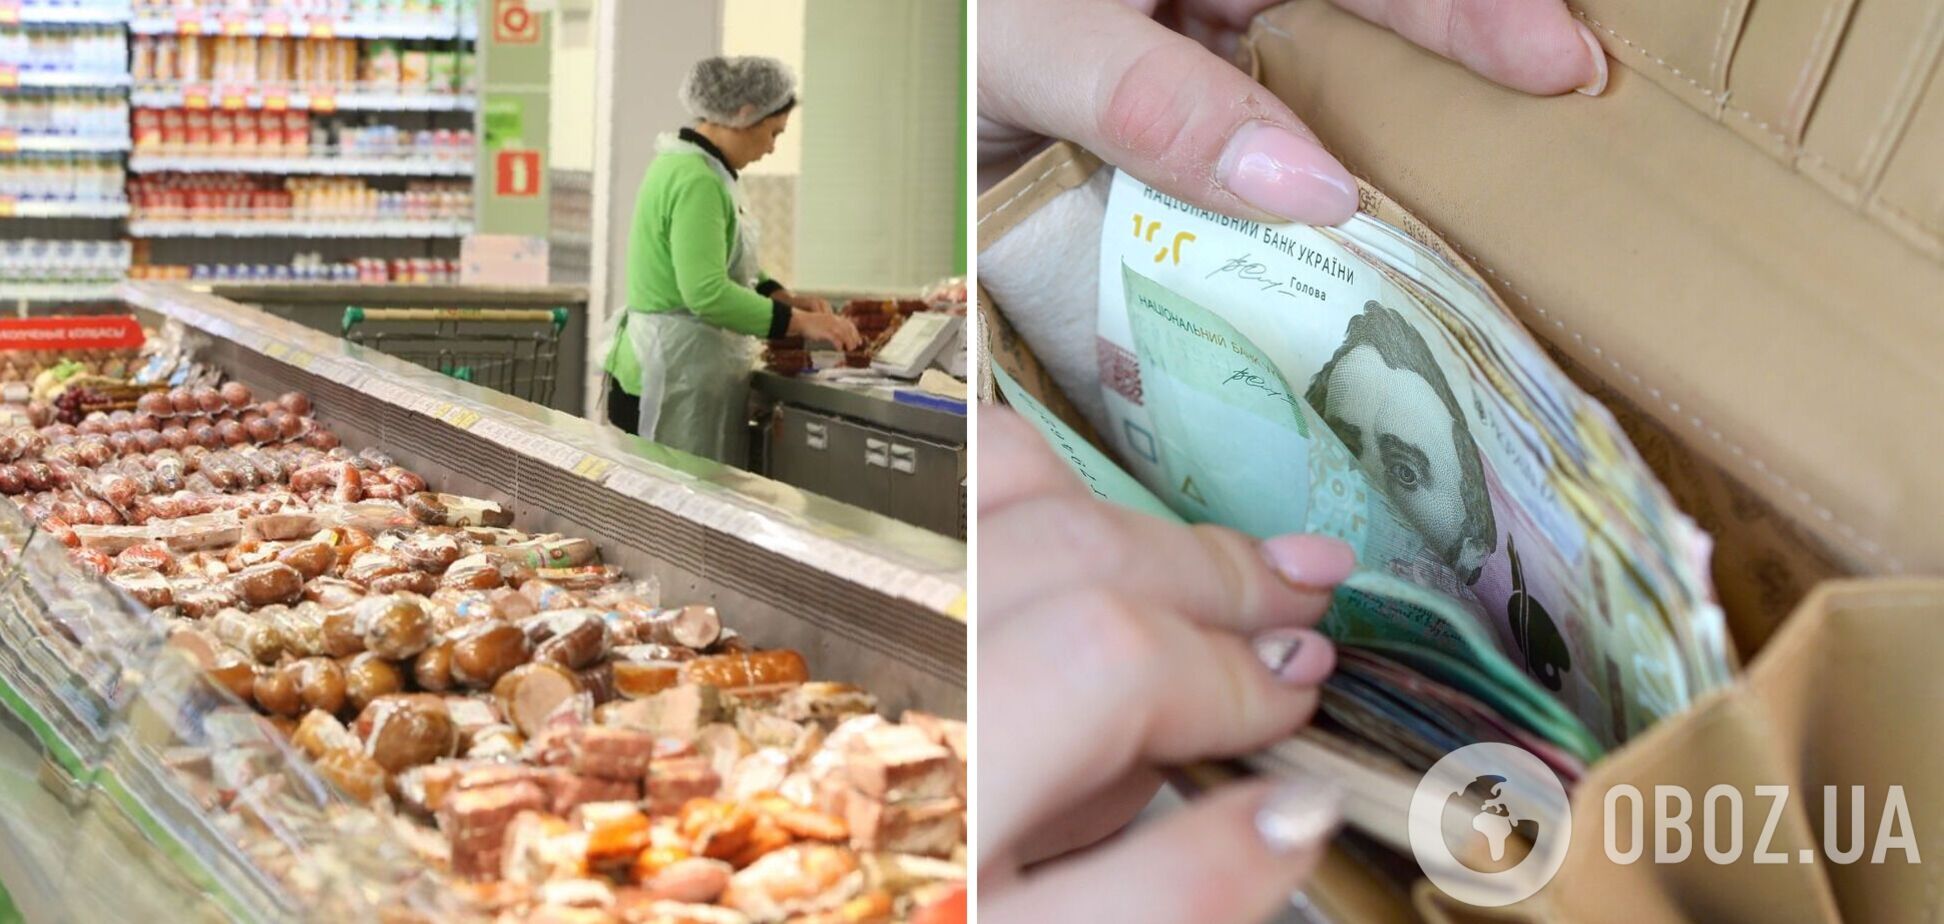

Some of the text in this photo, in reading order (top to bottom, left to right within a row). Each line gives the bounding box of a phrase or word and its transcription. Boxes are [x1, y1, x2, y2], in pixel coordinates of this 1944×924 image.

[1262, 227, 1297, 257] БАНК
[1297, 244, 1355, 286] УКРАЇНИ
[1289, 275, 1327, 302] Голова
